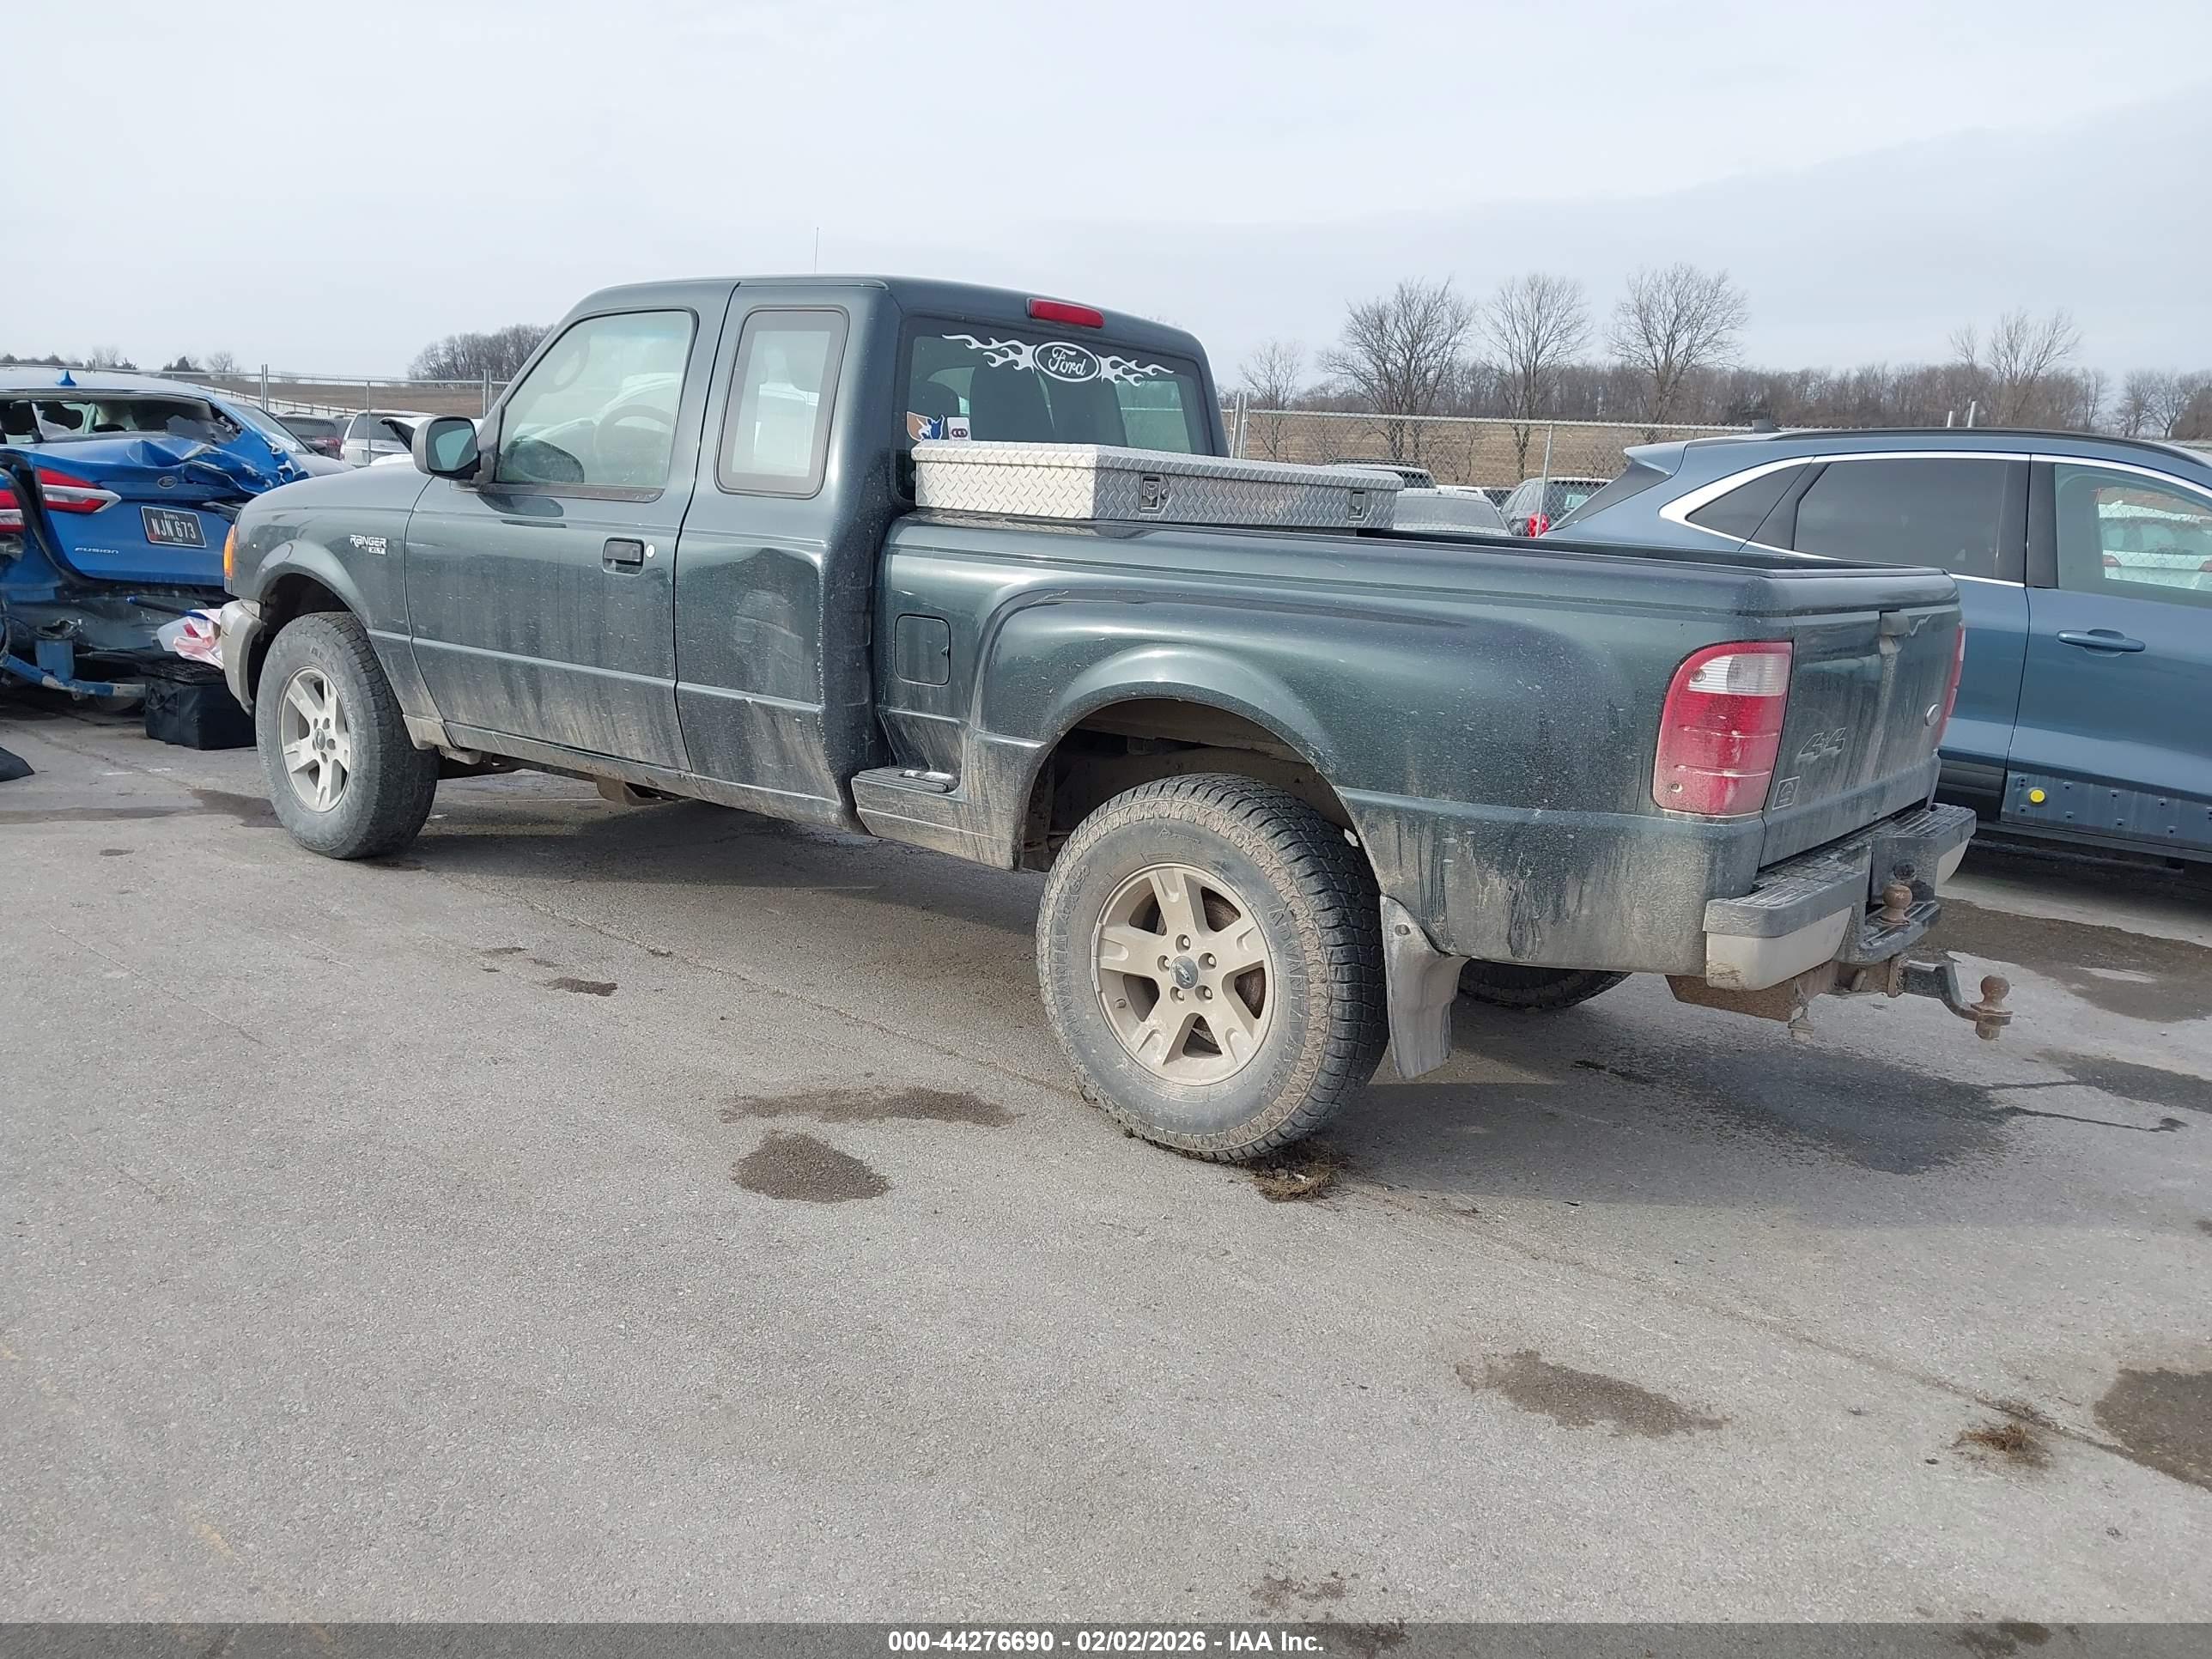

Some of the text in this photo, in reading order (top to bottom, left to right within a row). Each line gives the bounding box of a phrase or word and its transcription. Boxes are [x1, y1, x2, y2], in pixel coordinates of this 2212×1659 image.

[1048, 346, 1087, 376] Ford
[151, 518, 197, 539] NJN 673
[349, 534, 386, 548] RANGER
